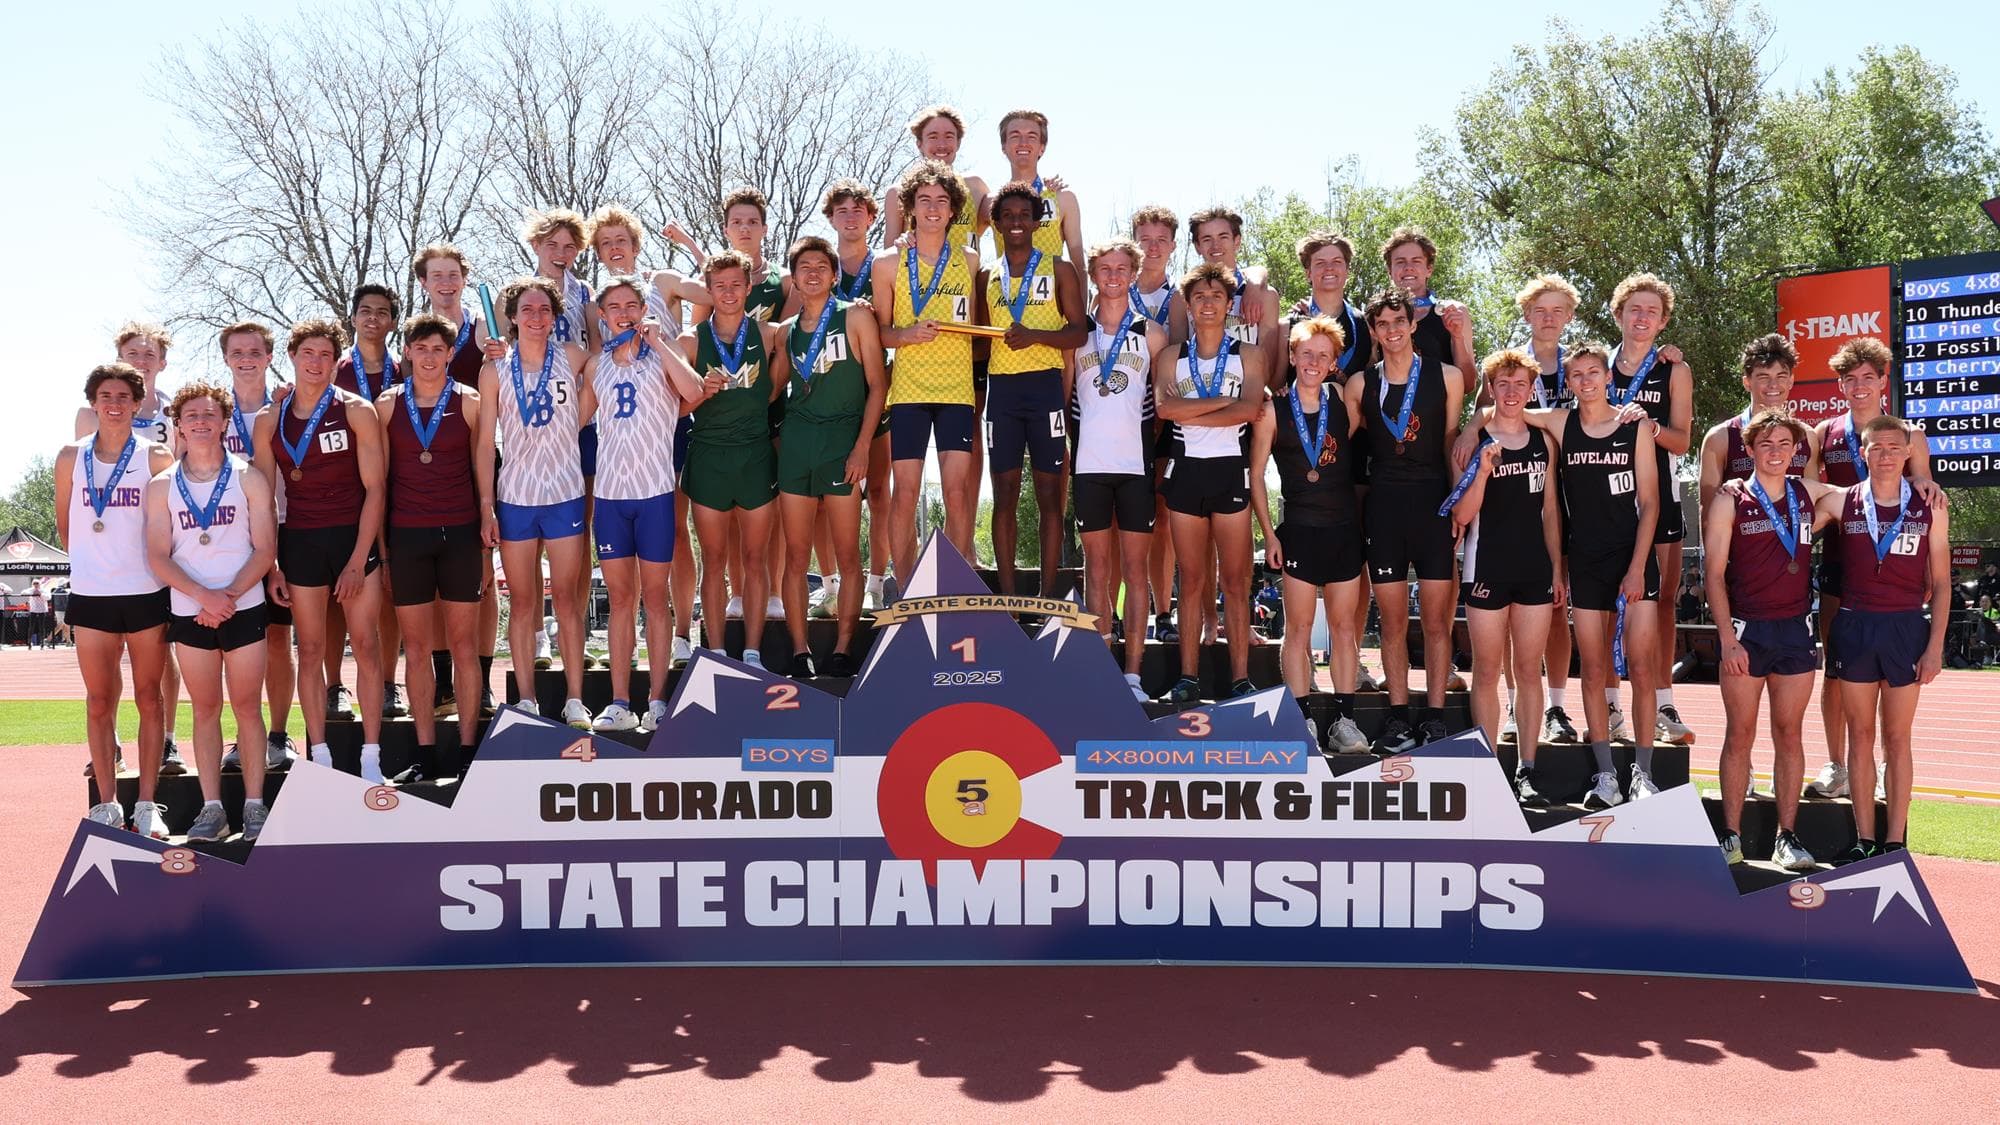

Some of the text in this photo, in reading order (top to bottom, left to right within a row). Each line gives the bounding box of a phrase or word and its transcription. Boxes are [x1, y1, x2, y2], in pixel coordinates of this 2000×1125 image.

[1037, 277, 1049, 298] 4
[1905, 282, 1950, 298] Boys
[956, 297, 967, 320] 4
[1906, 300, 2000, 322] 10 Thunde
[1907, 325, 1927, 339] 11
[1938, 321, 1981, 337] Pine
[831, 336, 840, 359] 1
[1125, 336, 1139, 352] 11
[1906, 338, 2000, 359] 12 Fossil
[1905, 359, 2000, 377] 13 Cherry
[556, 381, 567, 404] 5
[1904, 378, 1979, 396] 14 Erie
[613, 381, 637, 419] B
[1800, 398, 1827, 413] Prep
[1908, 400, 1927, 414] 15
[1053, 411, 1064, 435] 4
[1937, 414, 2000, 431] Castle
[324, 431, 343, 451] 13
[1937, 436, 1992, 450] Vista
[1568, 452, 1629, 465] LOVELAND
[1937, 456, 2000, 474] Dougla
[1493, 461, 1547, 478] LOVELAND
[1614, 473, 1631, 492] 10
[178, 505, 236, 531] COINS
[1897, 534, 1914, 554] 15
[7, 563, 33, 571] Locally
[36, 563, 55, 571] since
[898, 597, 1072, 614] STATE CHAMPION
[951, 637, 977, 663] 1
[933, 671, 1003, 686] 2025
[765, 684, 801, 711] 2
[1178, 711, 1213, 737] 3
[561, 736, 598, 763] 4
[749, 747, 829, 764] BOYS
[1087, 750, 1300, 765] 4X800M RELAY
[1380, 756, 1415, 783] 5
[364, 785, 400, 811] 6
[539, 780, 833, 822] COLORADO
[956, 779, 989, 804] 5
[1076, 780, 1468, 822] TRACK & FIELD
[961, 801, 986, 817] a
[1579, 815, 1615, 844] 7
[160, 847, 197, 875] 8
[439, 858, 1545, 932] STATE CHAMPIONSHIPS
[1787, 881, 1827, 910] 9
